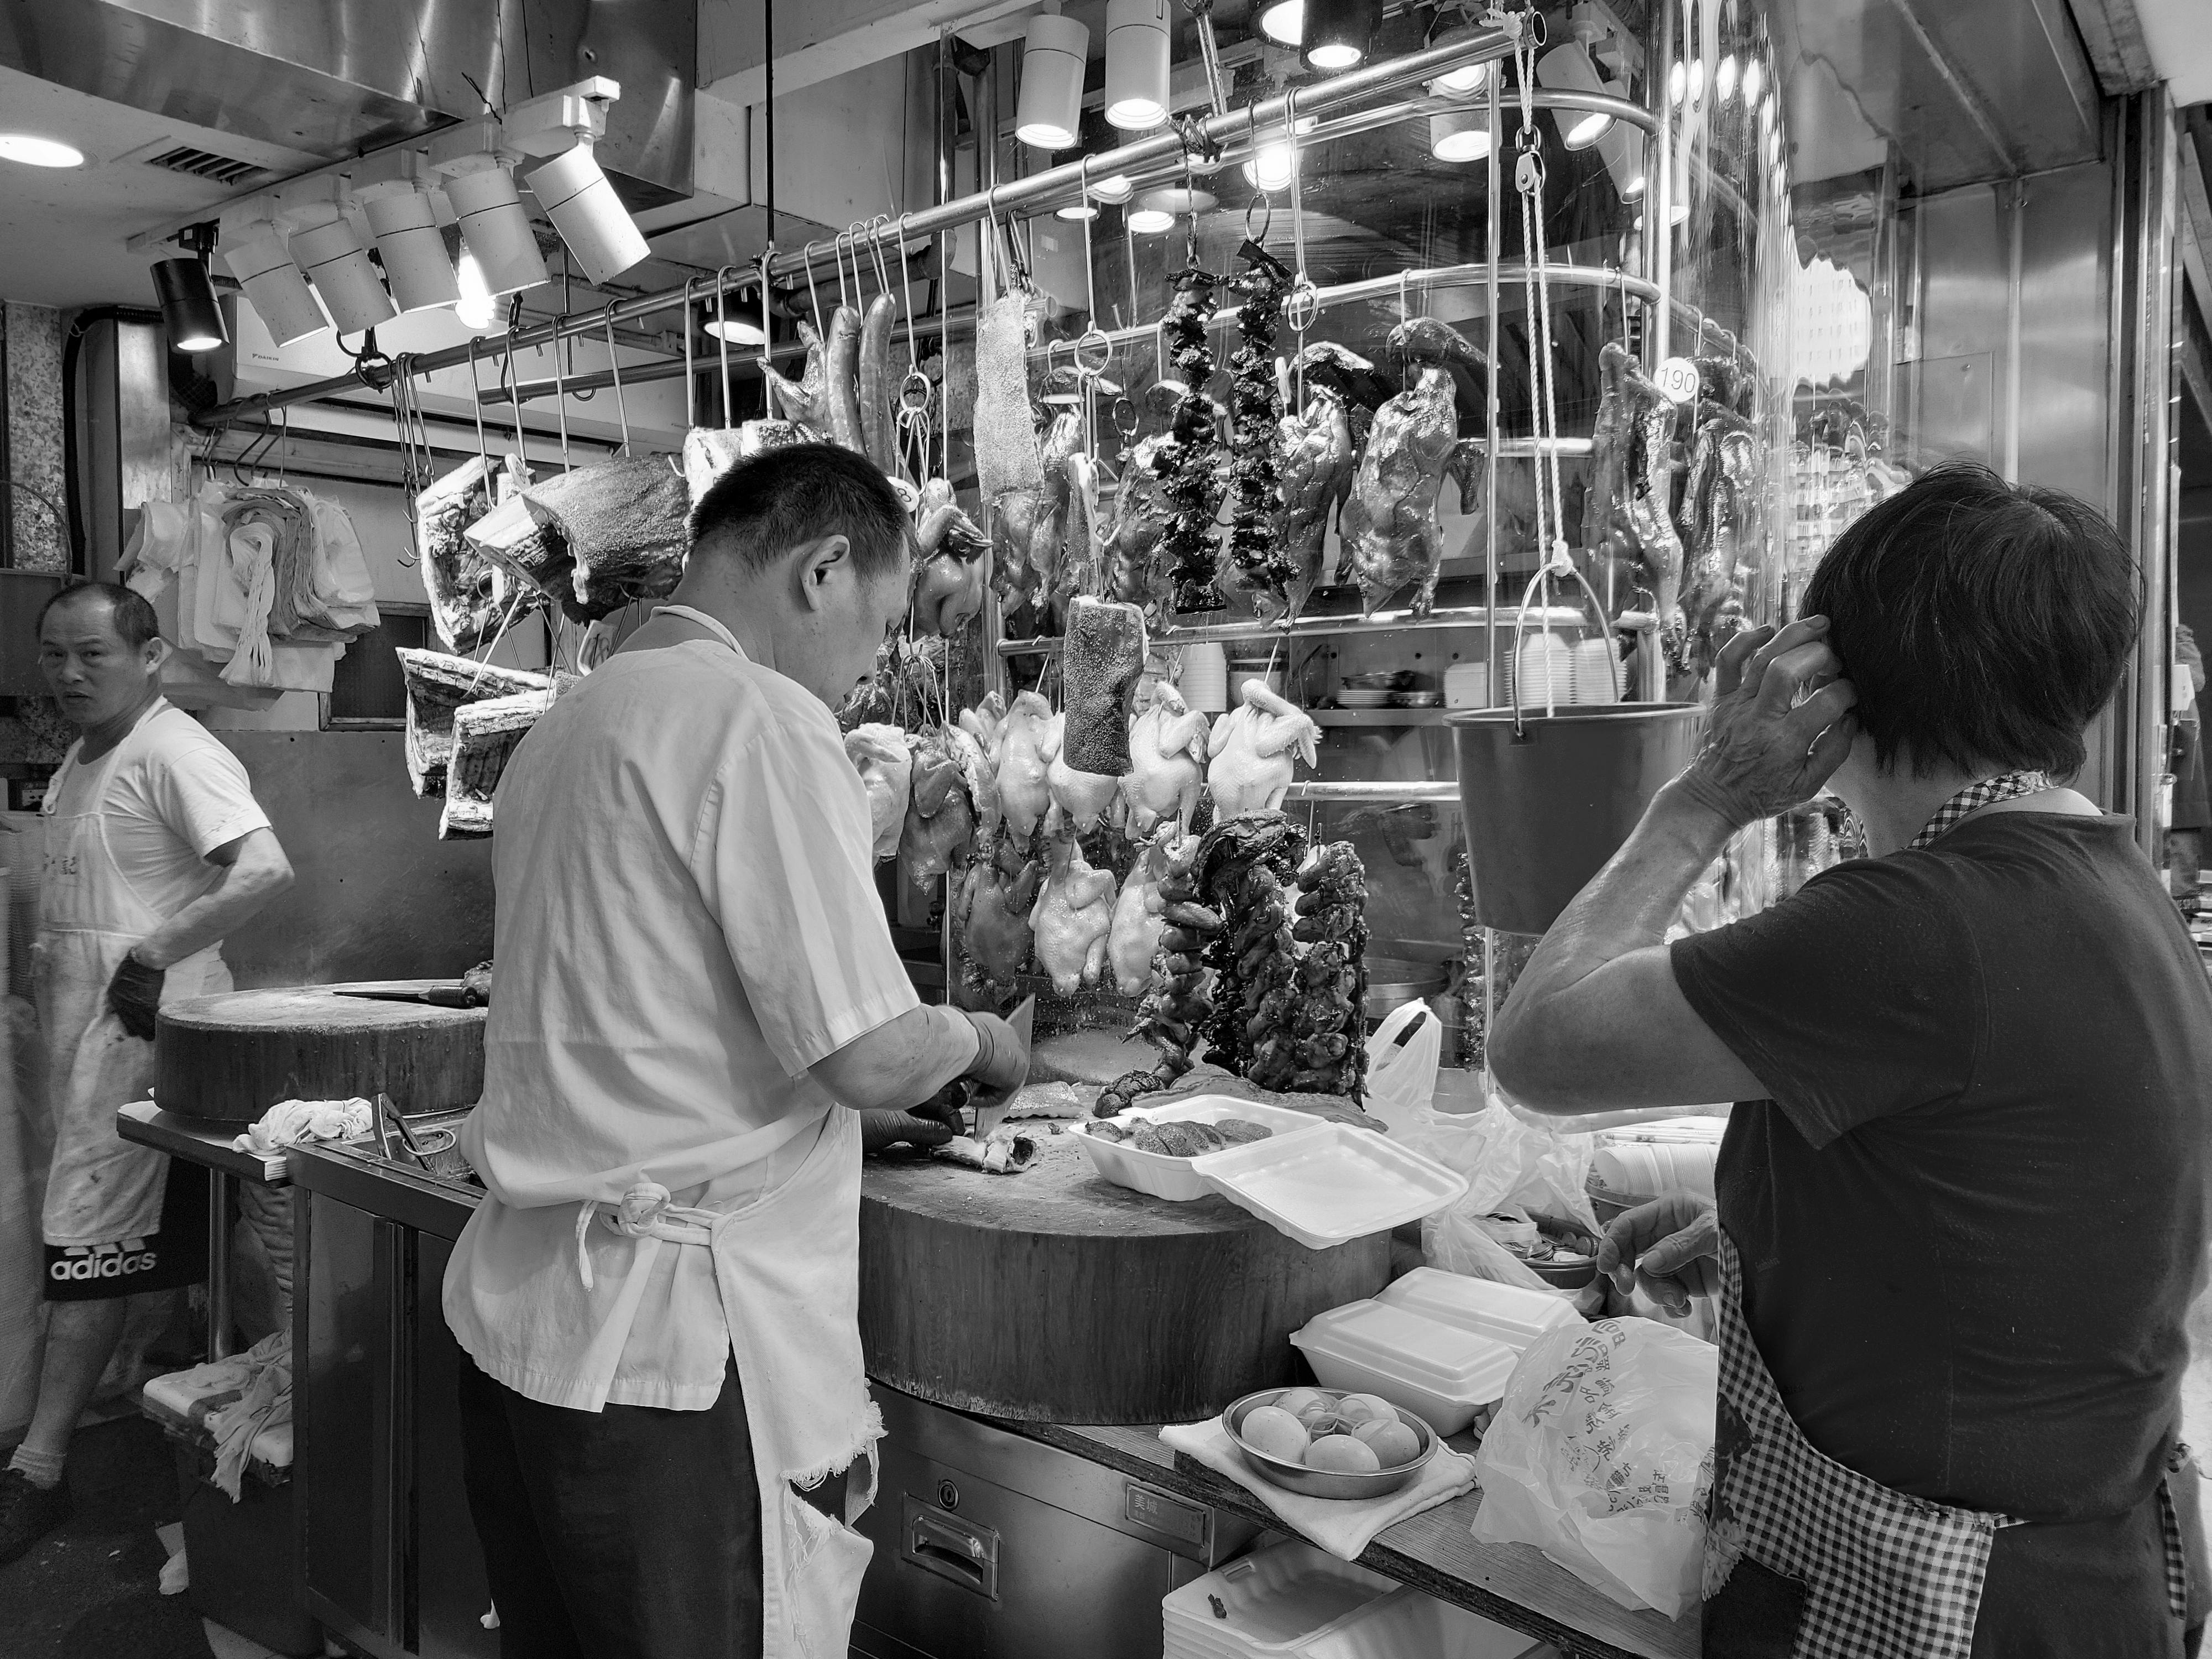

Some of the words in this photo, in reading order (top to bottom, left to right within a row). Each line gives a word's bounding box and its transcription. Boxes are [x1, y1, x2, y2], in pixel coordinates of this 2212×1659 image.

[1661, 367, 1695, 393] 190
[50, 1251, 157, 1281] adidas
[1134, 1494, 1159, 1515] 美城
